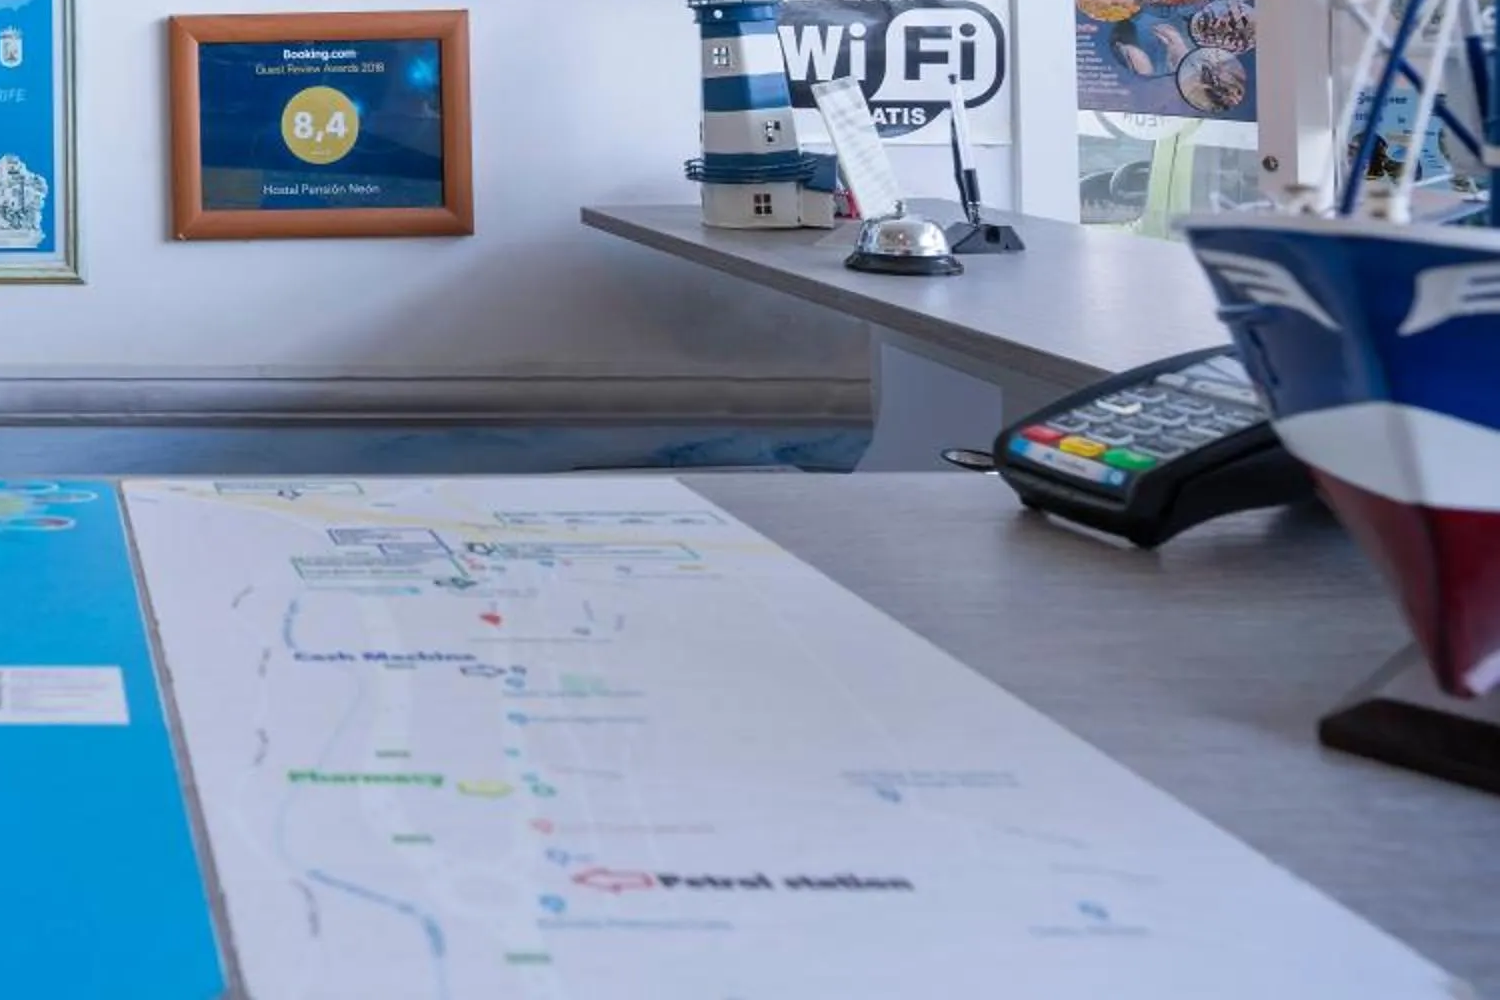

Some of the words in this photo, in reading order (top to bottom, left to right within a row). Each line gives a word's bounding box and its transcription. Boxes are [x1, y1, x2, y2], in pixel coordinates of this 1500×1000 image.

[283, 49, 357, 61] Booking.com
[255, 64, 285, 75] Guest
[287, 64, 321, 74] Review
[323, 63, 359, 74] Awards
[293, 111, 348, 142] 8,4
[263, 184, 299, 195] Hostal
[655, 872, 774, 892] Petrol
[782, 872, 915, 892] station
